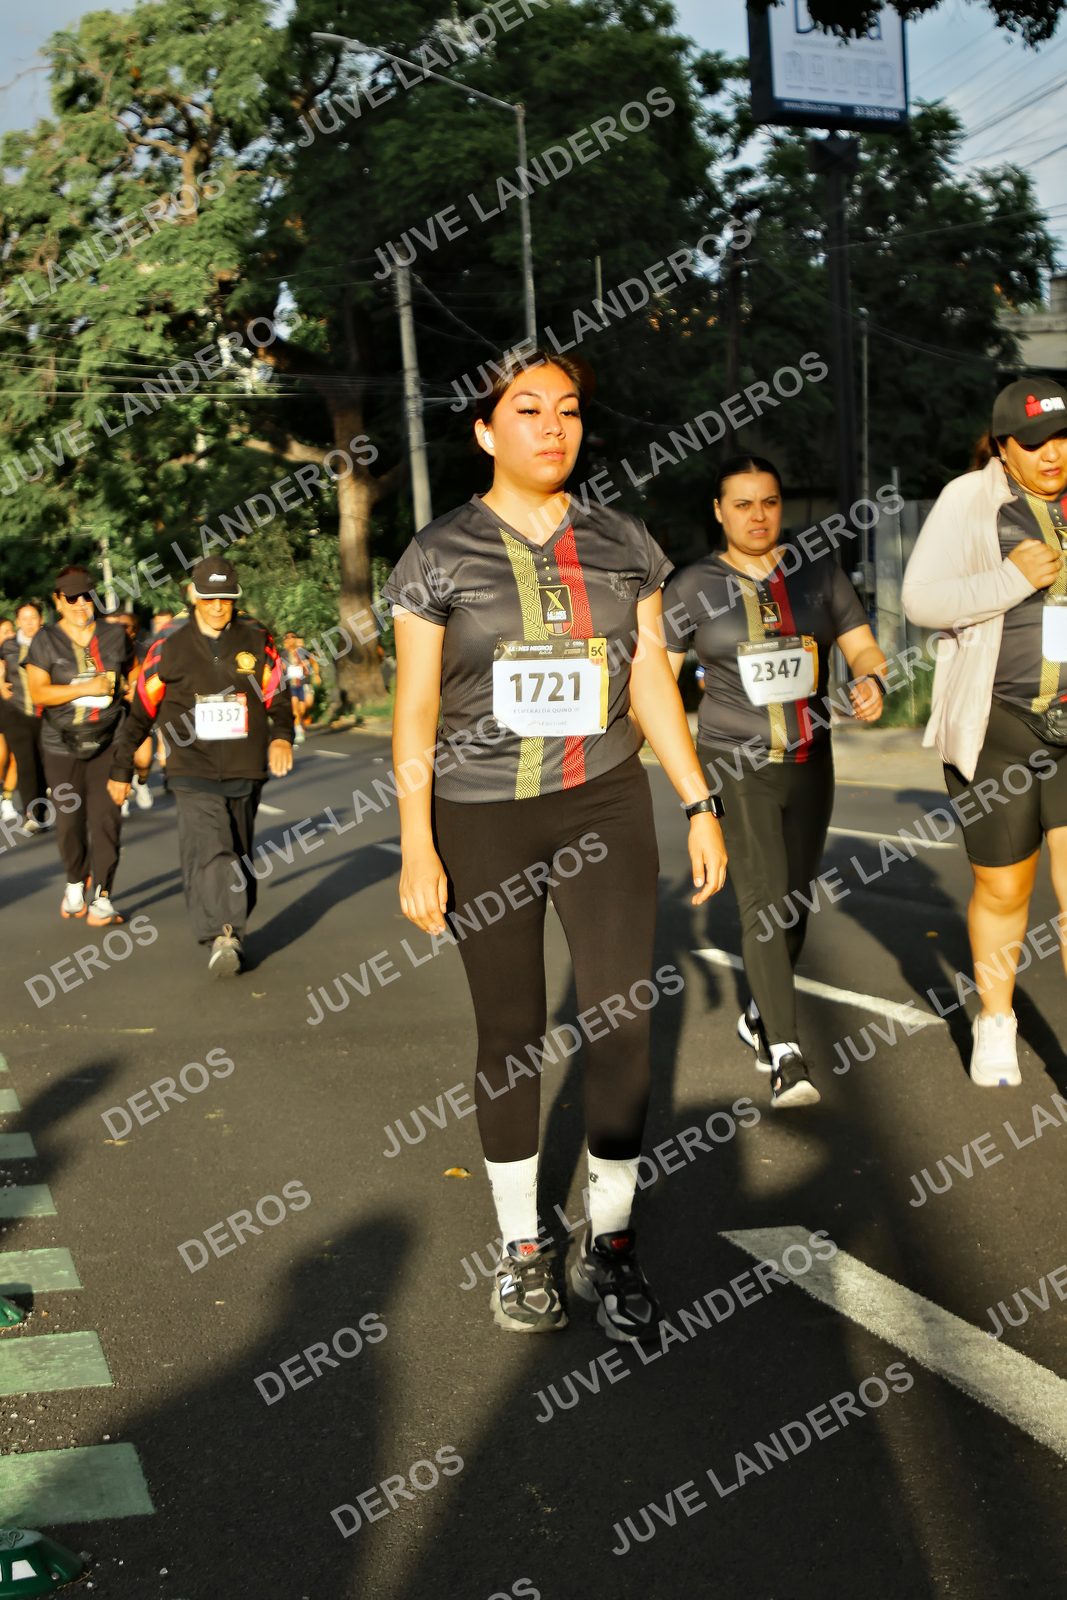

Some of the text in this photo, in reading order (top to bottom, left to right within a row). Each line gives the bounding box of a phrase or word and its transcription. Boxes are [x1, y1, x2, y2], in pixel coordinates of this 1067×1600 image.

[751, 657, 801, 683] 2347
[509, 671, 581, 702] 1721
[201, 708, 241, 722] 11357
